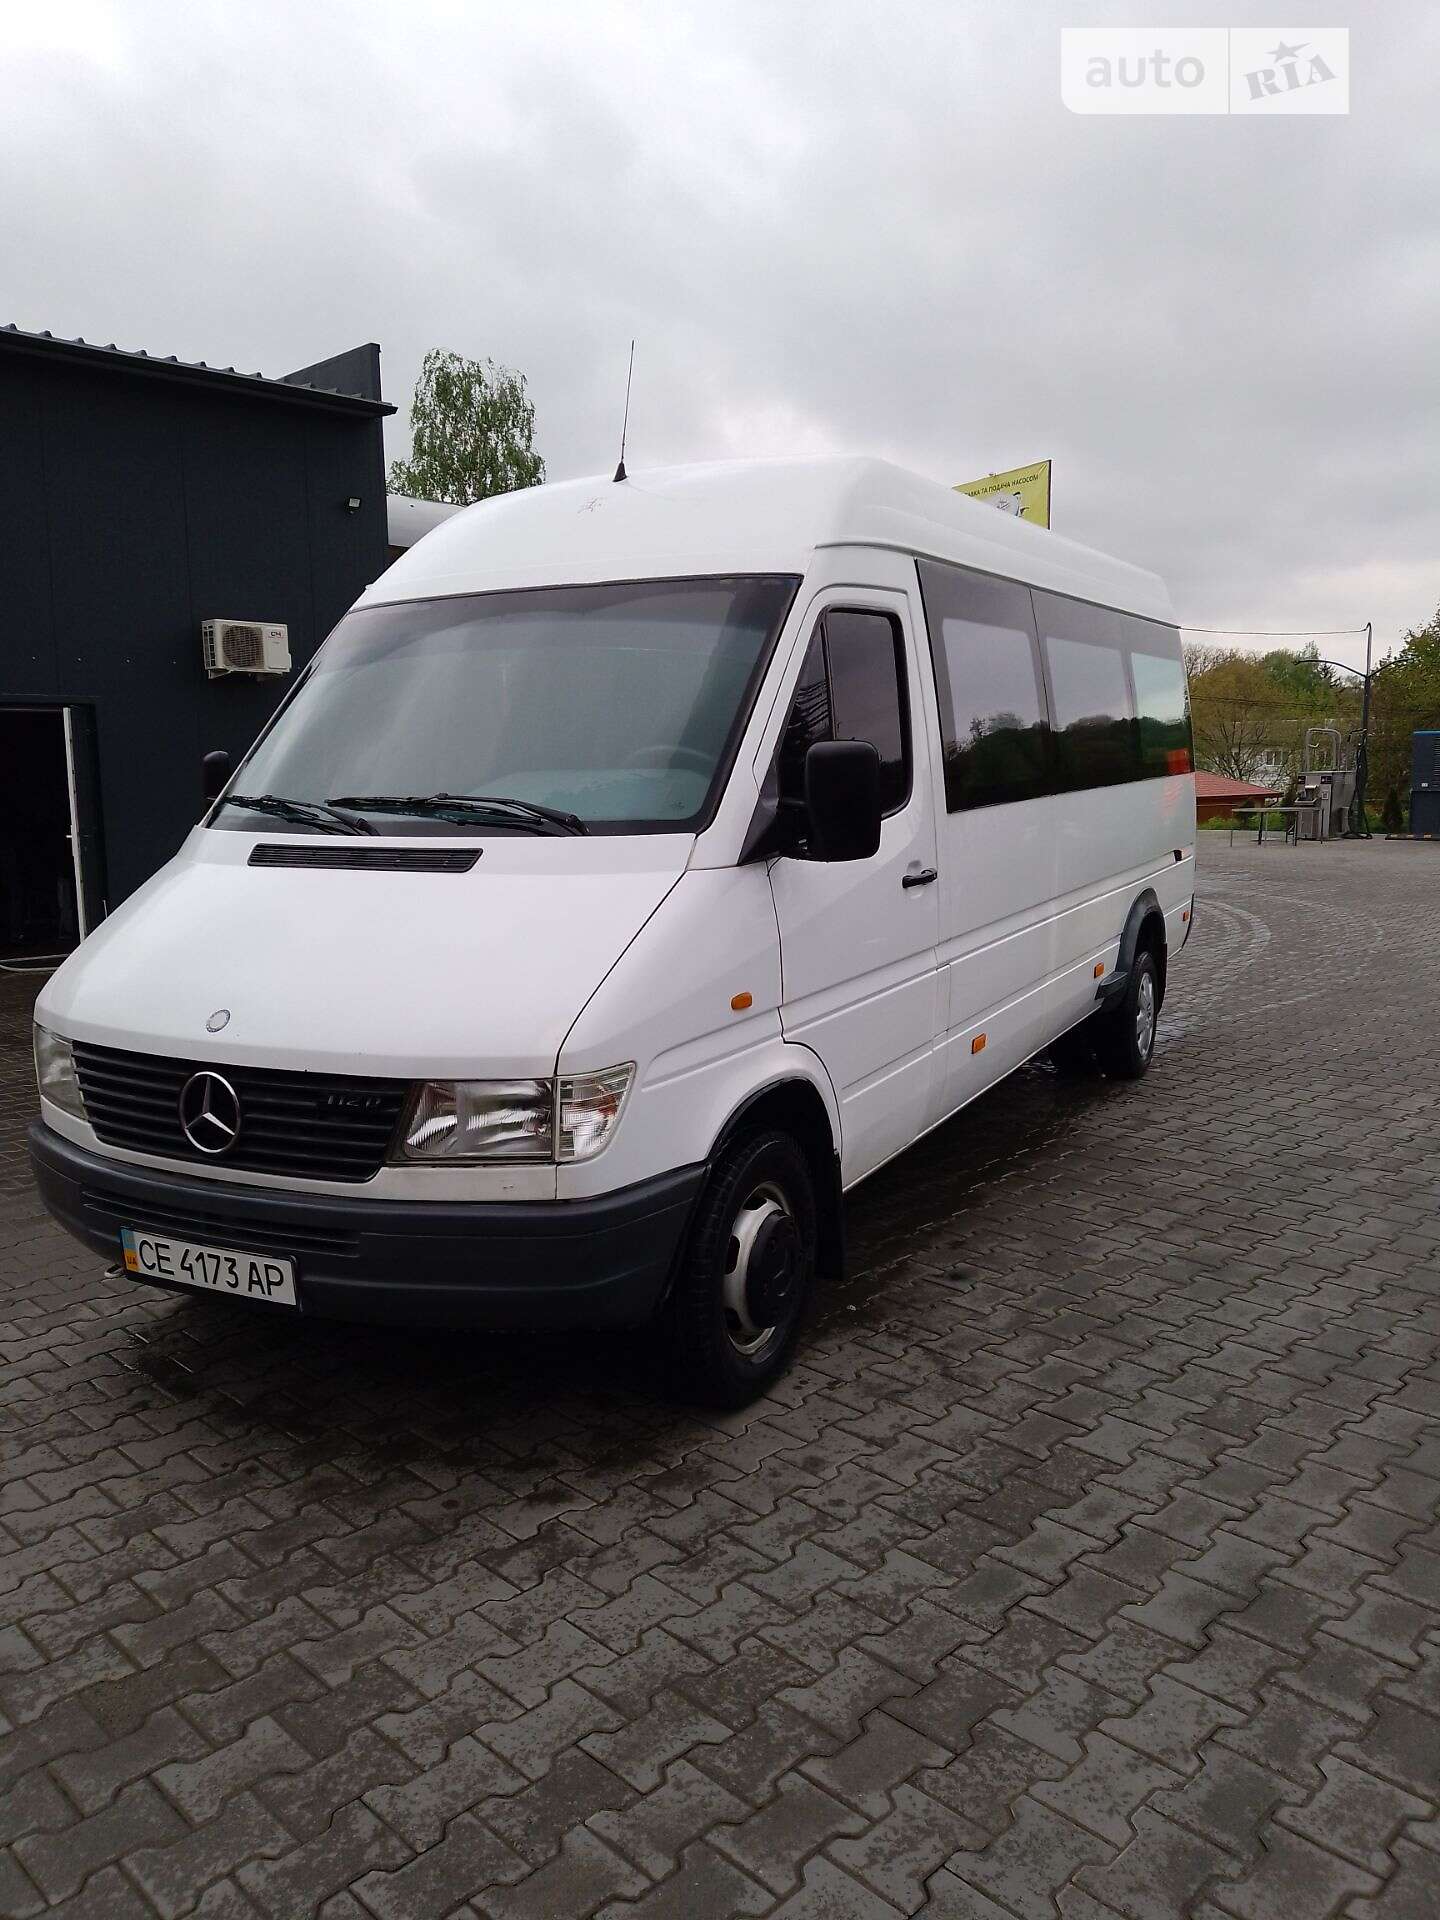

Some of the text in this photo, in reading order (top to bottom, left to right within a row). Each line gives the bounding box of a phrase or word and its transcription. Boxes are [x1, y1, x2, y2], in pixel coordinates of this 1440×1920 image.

[989, 481, 1010, 493] ПОДАЧА
[1011, 474, 1038, 486] НАСОСОМ
[138, 1239, 285, 1296] CE 4173 AP
